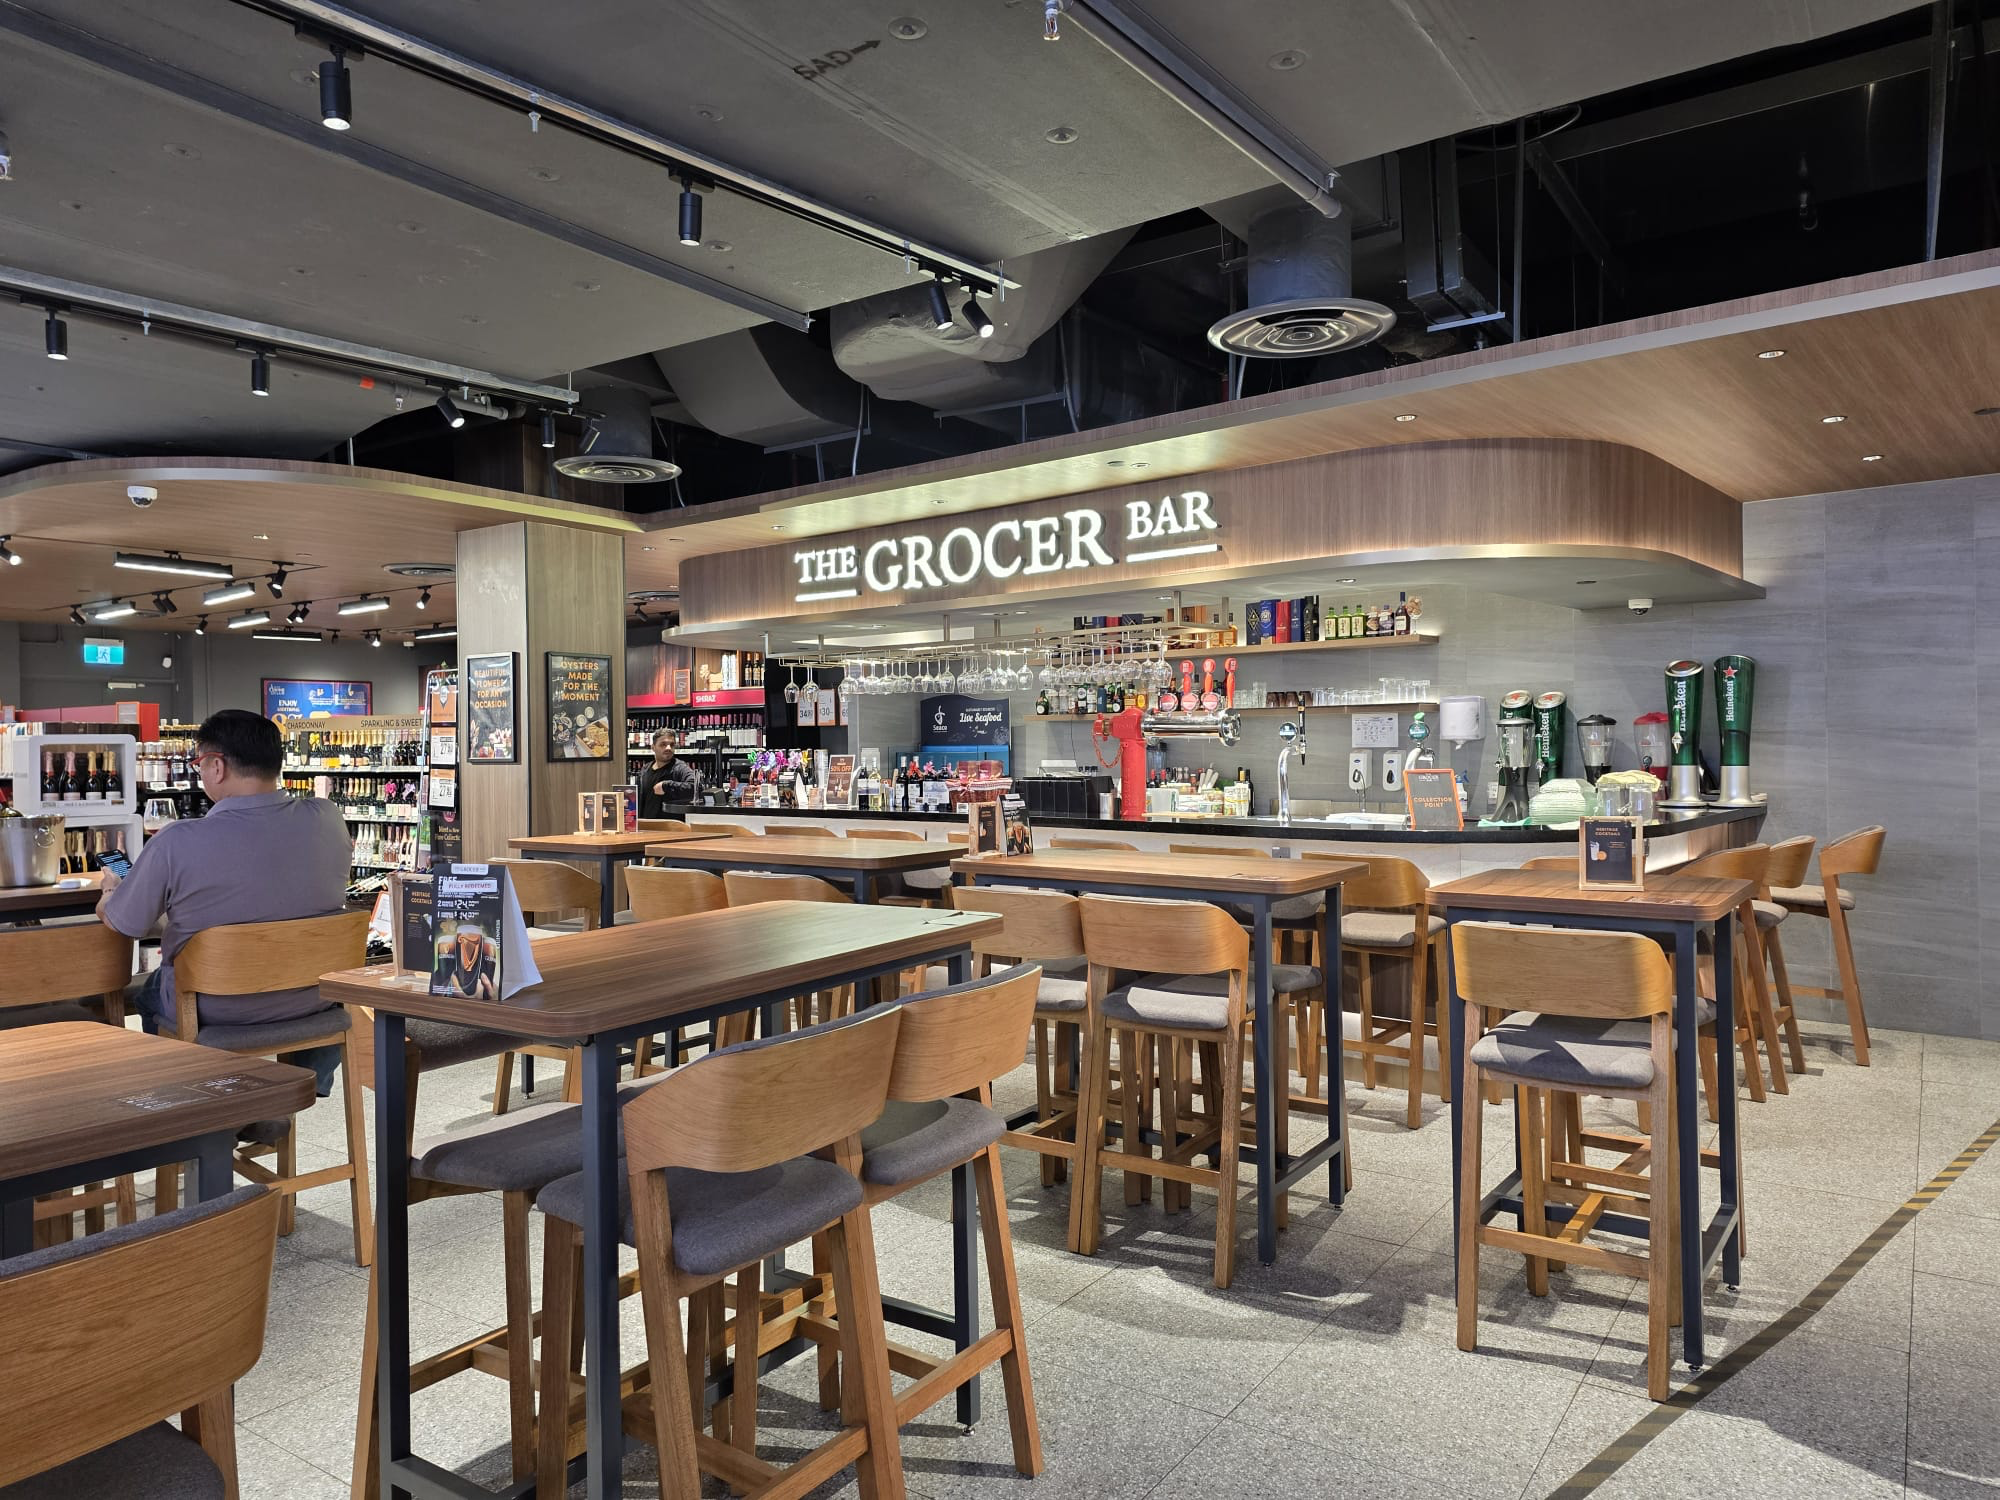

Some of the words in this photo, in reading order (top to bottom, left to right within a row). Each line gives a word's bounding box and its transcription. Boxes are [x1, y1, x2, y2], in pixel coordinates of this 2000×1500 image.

[794, 545, 857, 584] THE
[864, 508, 1114, 592] GROCER
[1126, 491, 1218, 540] BAR
[560, 661, 599, 671] OYSTERS
[474, 668, 507, 678] BEAUTIFUL
[568, 672, 593, 681] MADE
[476, 679, 504, 687] FLOWERS
[563, 682, 579, 690] FOR
[582, 682, 598, 690] THE
[477, 690, 490, 698] FOR
[490, 690, 503, 698] ANY
[561, 693, 600, 701] MOMENT
[474, 700, 507, 709] OCCASION
[1725, 679, 1734, 722] Heineken
[360, 719, 395, 728] SPARKLING
[395, 719, 400, 727] &
[400, 718, 422, 727] SWEET
[959, 712, 974, 723] Live
[974, 712, 1002, 726] Seafood
[287, 720, 326, 730] CHARDONNAY
[1541, 712, 1550, 758] Heineken
